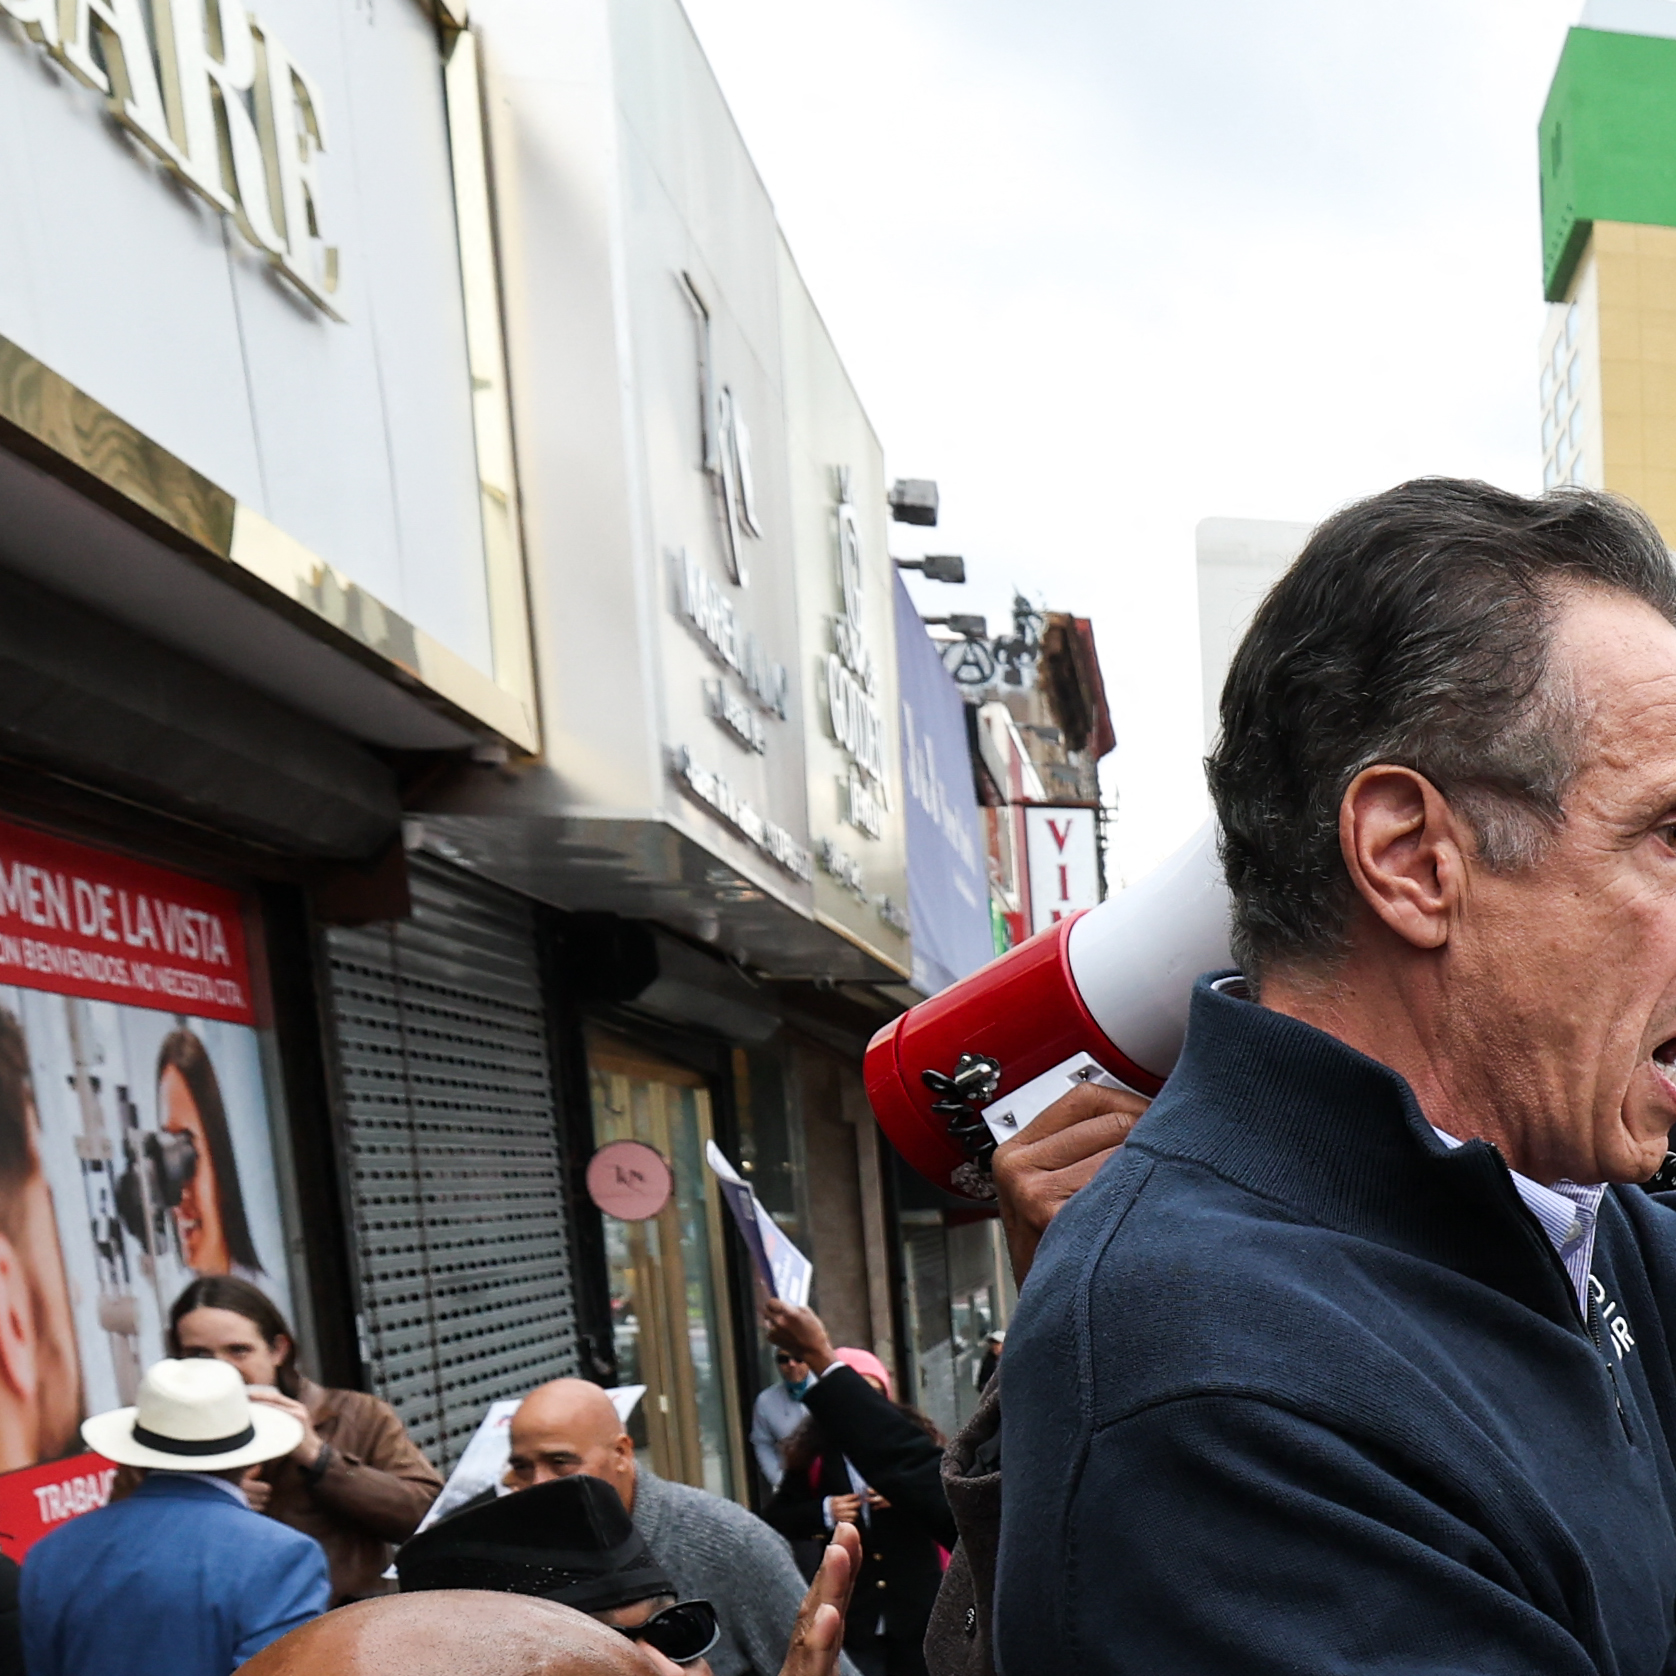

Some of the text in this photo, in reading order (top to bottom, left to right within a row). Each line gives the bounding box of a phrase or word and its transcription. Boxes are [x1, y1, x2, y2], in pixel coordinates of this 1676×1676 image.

[72, 876, 119, 942] DE
[118, 889, 160, 950] LA
[153, 898, 231, 967] VISTA
